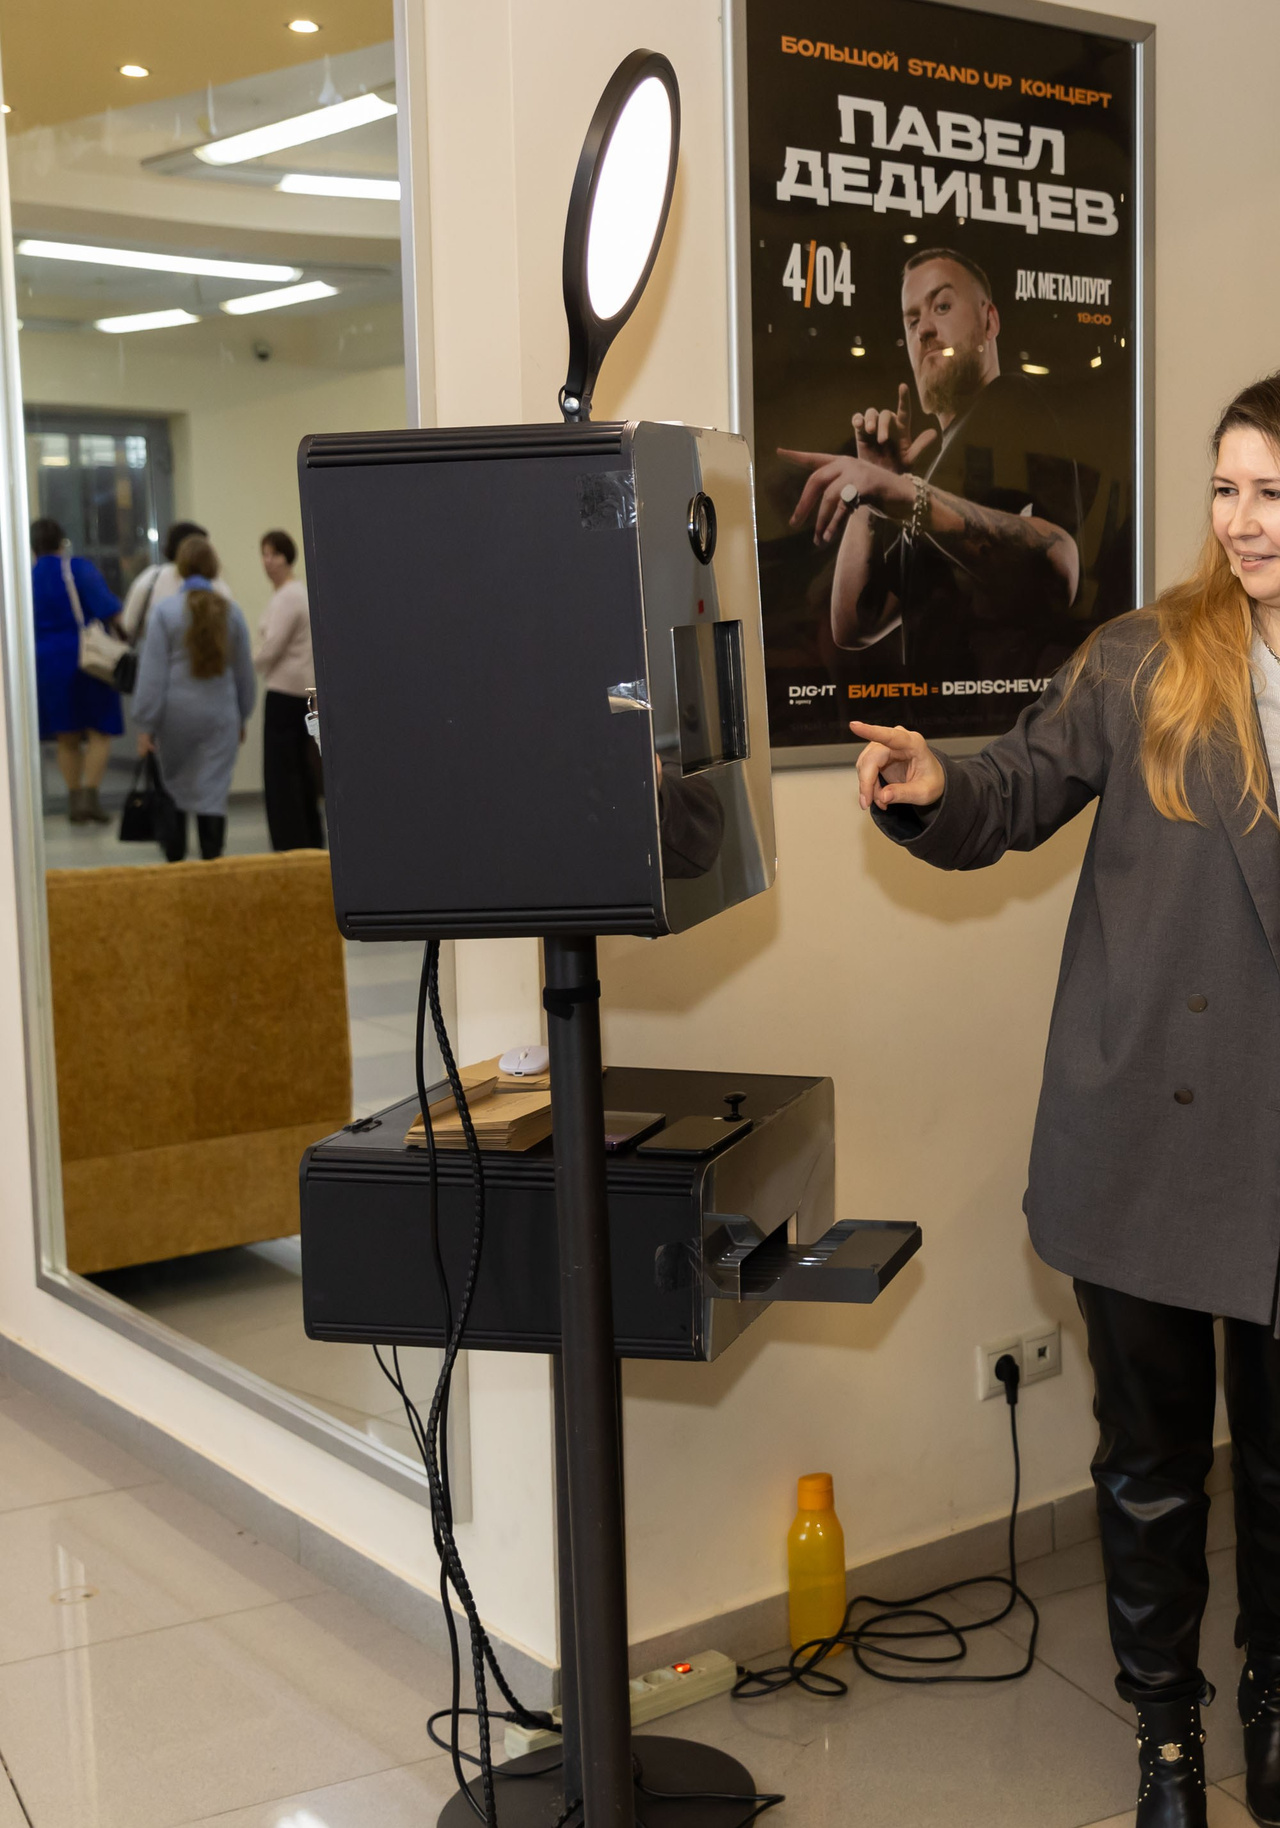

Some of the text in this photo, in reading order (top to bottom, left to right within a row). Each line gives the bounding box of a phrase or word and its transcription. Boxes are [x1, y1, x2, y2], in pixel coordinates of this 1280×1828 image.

[781, 35, 1113, 109] БОЛЬШОЙ STAND UP КОНЦЕРТ
[837, 94, 1066, 176] ПАВЕЛ
[776, 145, 1119, 237] ДЕДИЩЕВ
[782, 239, 856, 308] 4/04
[1015, 268, 1112, 306] ДК МЕТАЛЛУРГ
[1077, 312, 1112, 326] 19:00
[848, 682, 928, 699] БИЛЕТЫ
